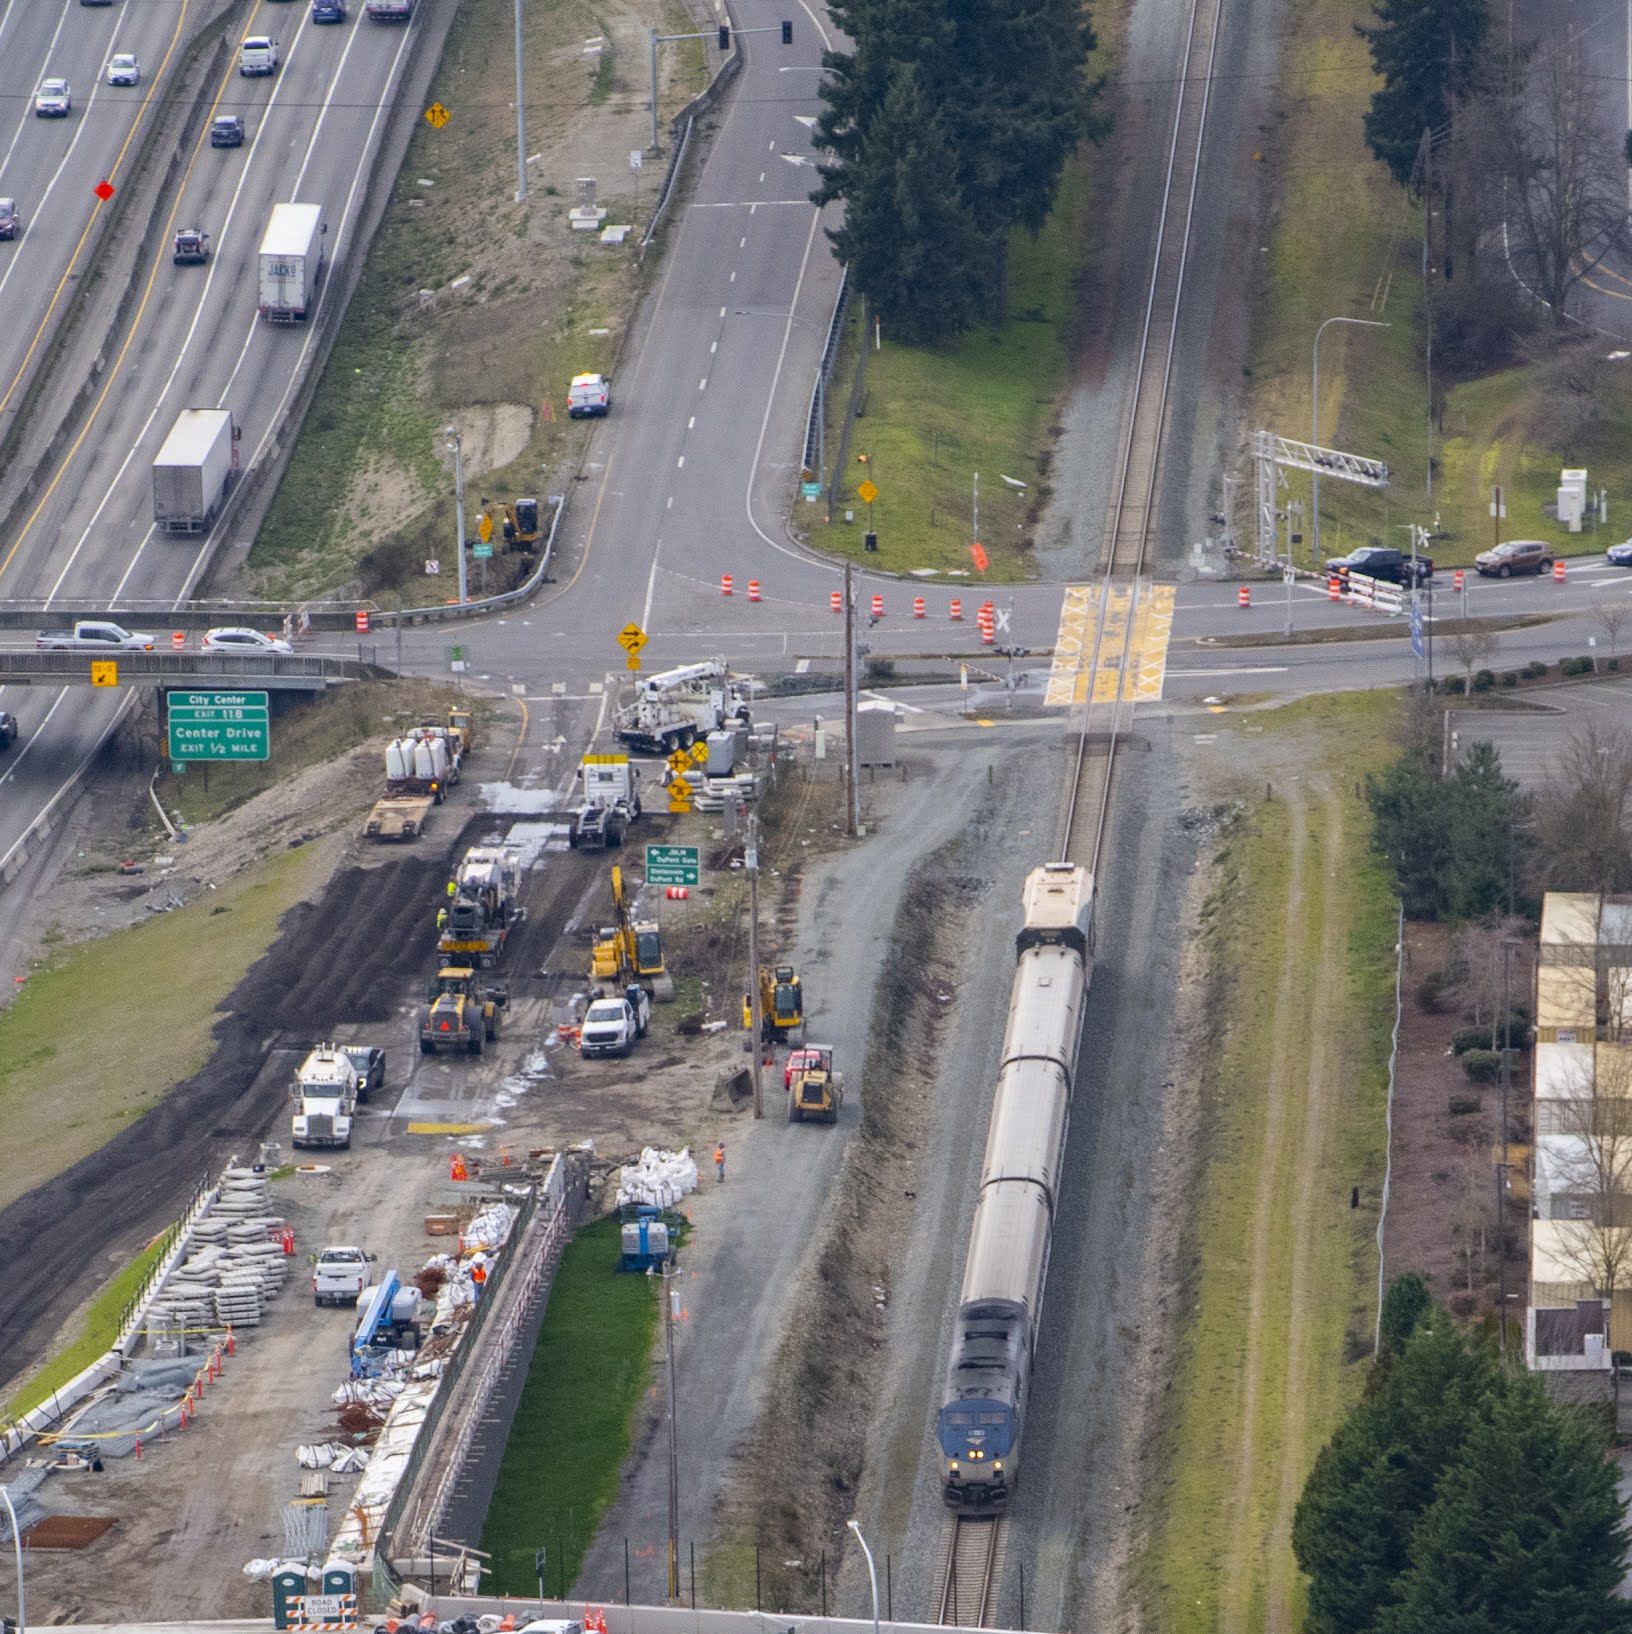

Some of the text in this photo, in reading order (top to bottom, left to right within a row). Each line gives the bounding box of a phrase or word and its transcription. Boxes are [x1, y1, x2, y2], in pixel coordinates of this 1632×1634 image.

[189, 695, 246, 705] City Center
[176, 728, 262, 738] Center Drive
[180, 744, 205, 752] EXIT
[231, 744, 257, 752] MILE
